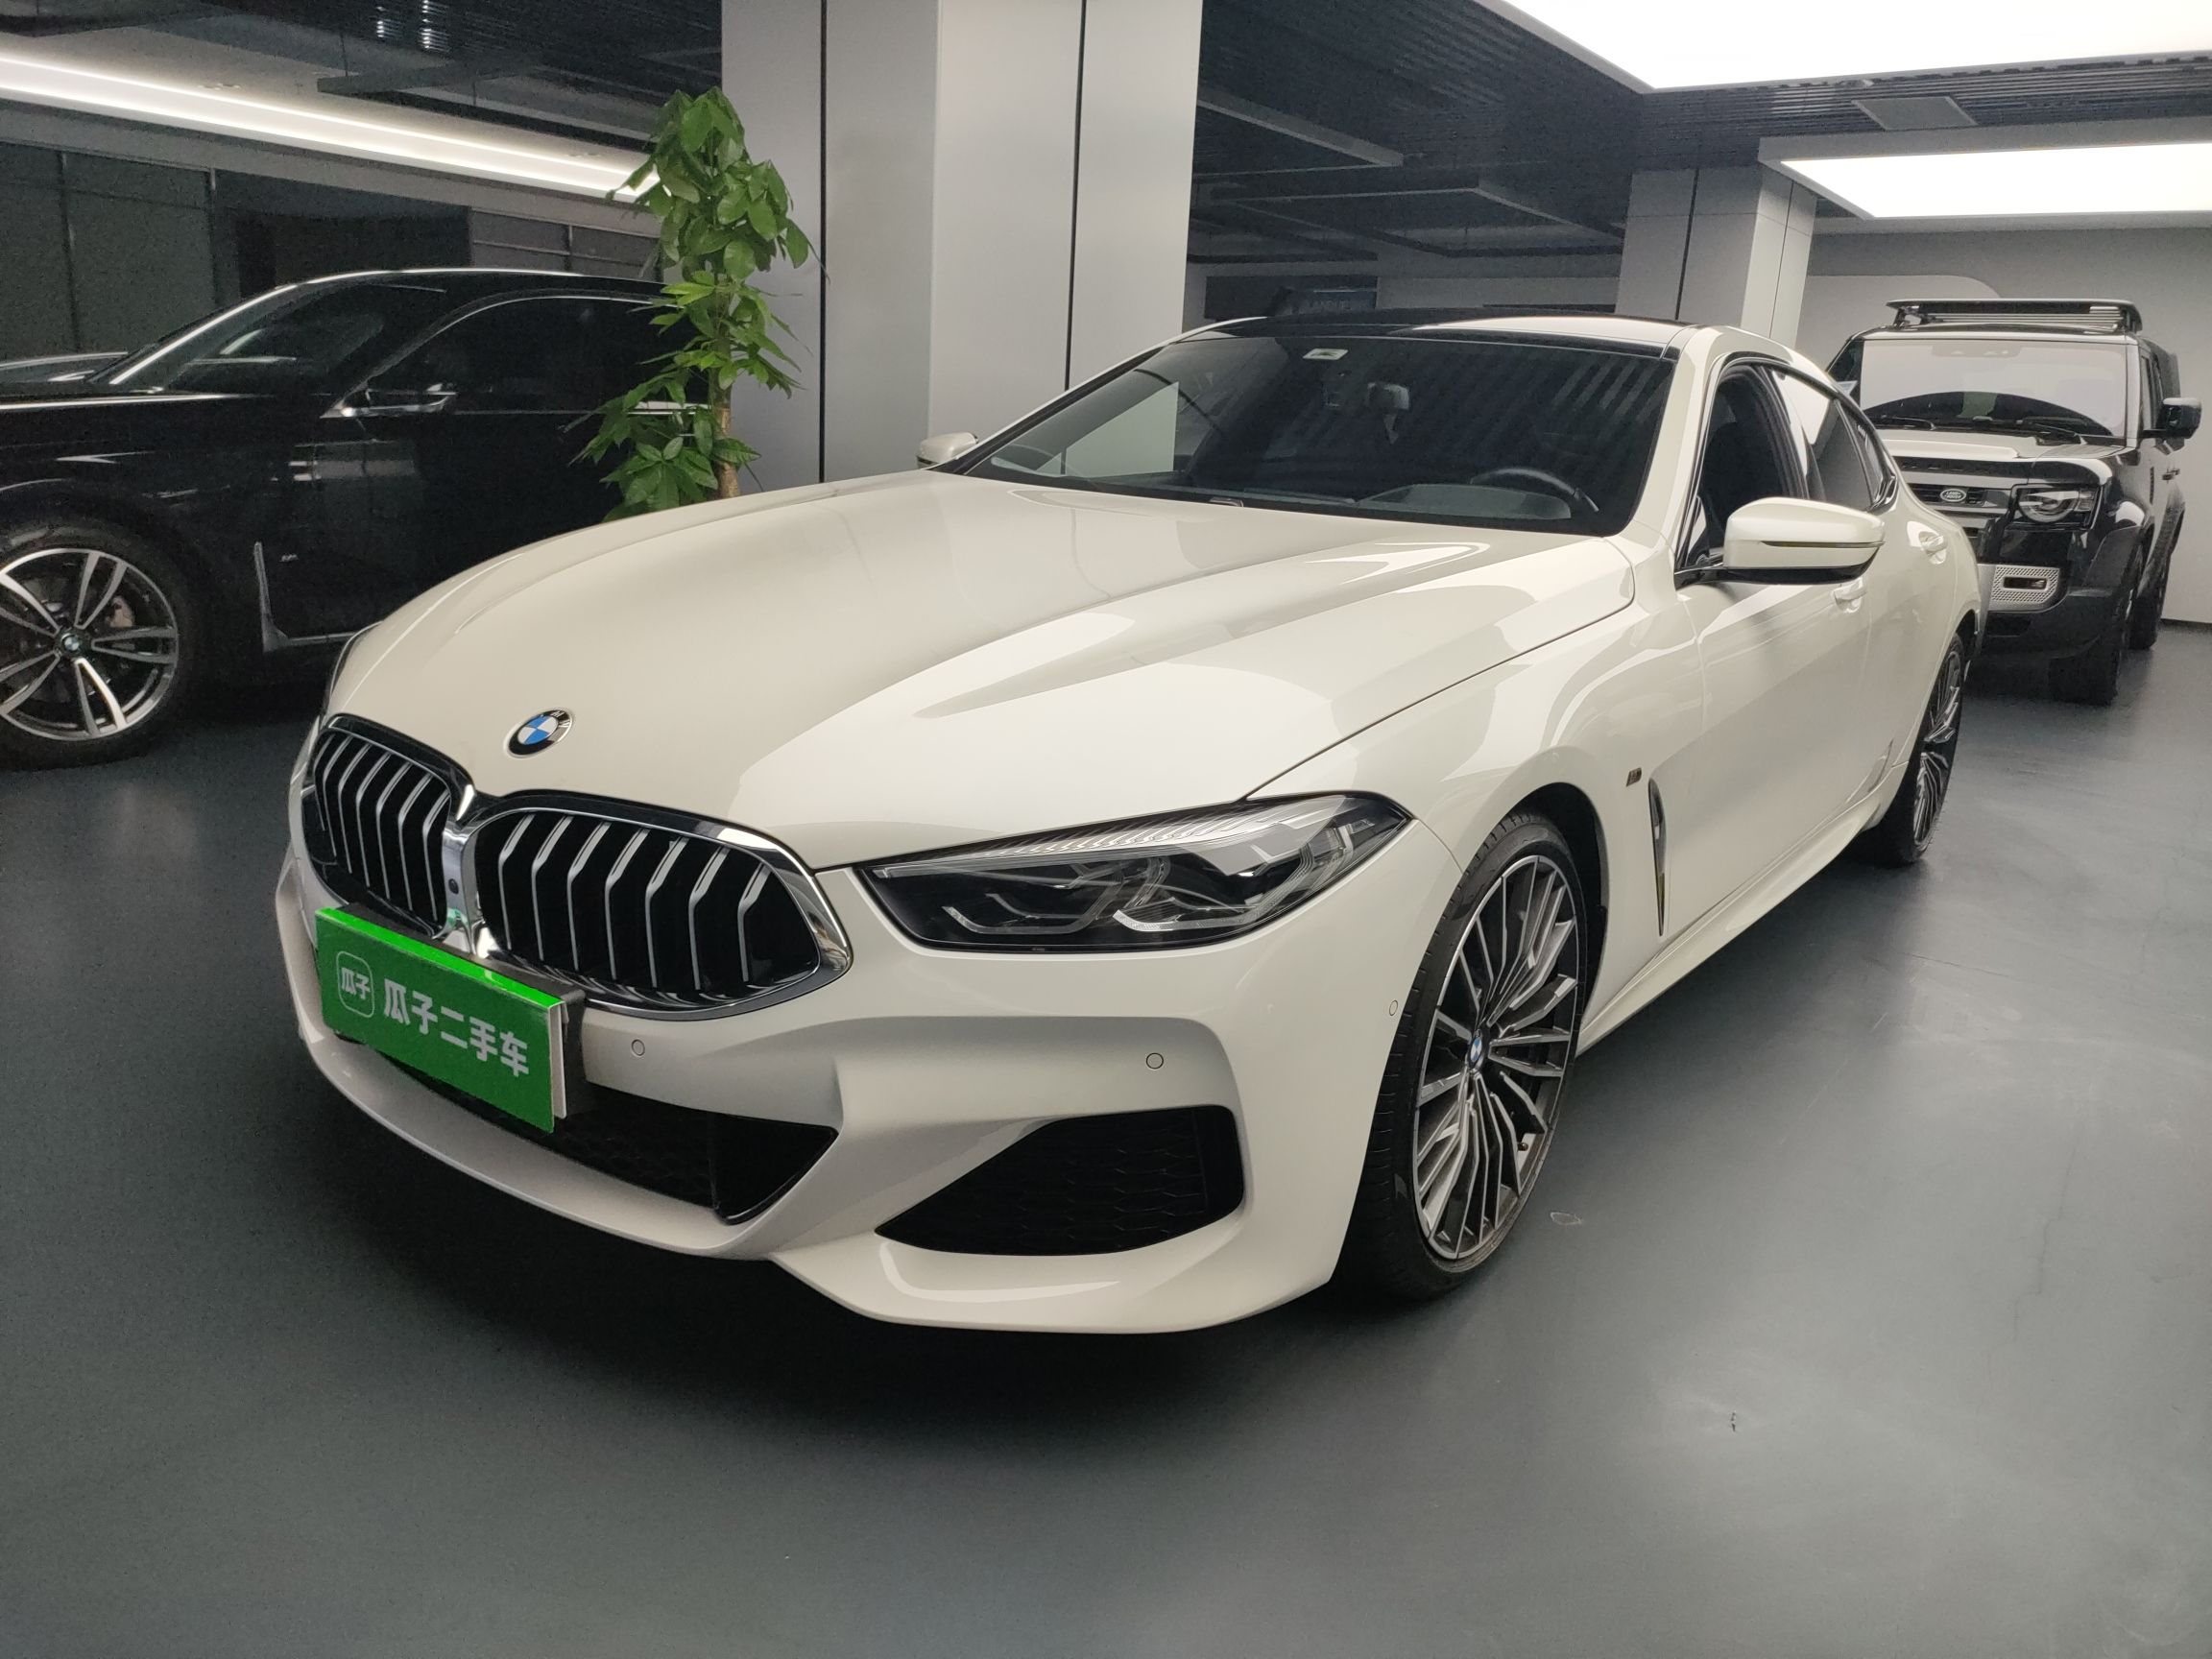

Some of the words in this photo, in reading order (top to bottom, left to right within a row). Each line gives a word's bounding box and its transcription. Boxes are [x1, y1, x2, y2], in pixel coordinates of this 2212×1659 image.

[341, 967, 372, 1000] 瓜子
[383, 977, 529, 1078] 瓜子二手车
